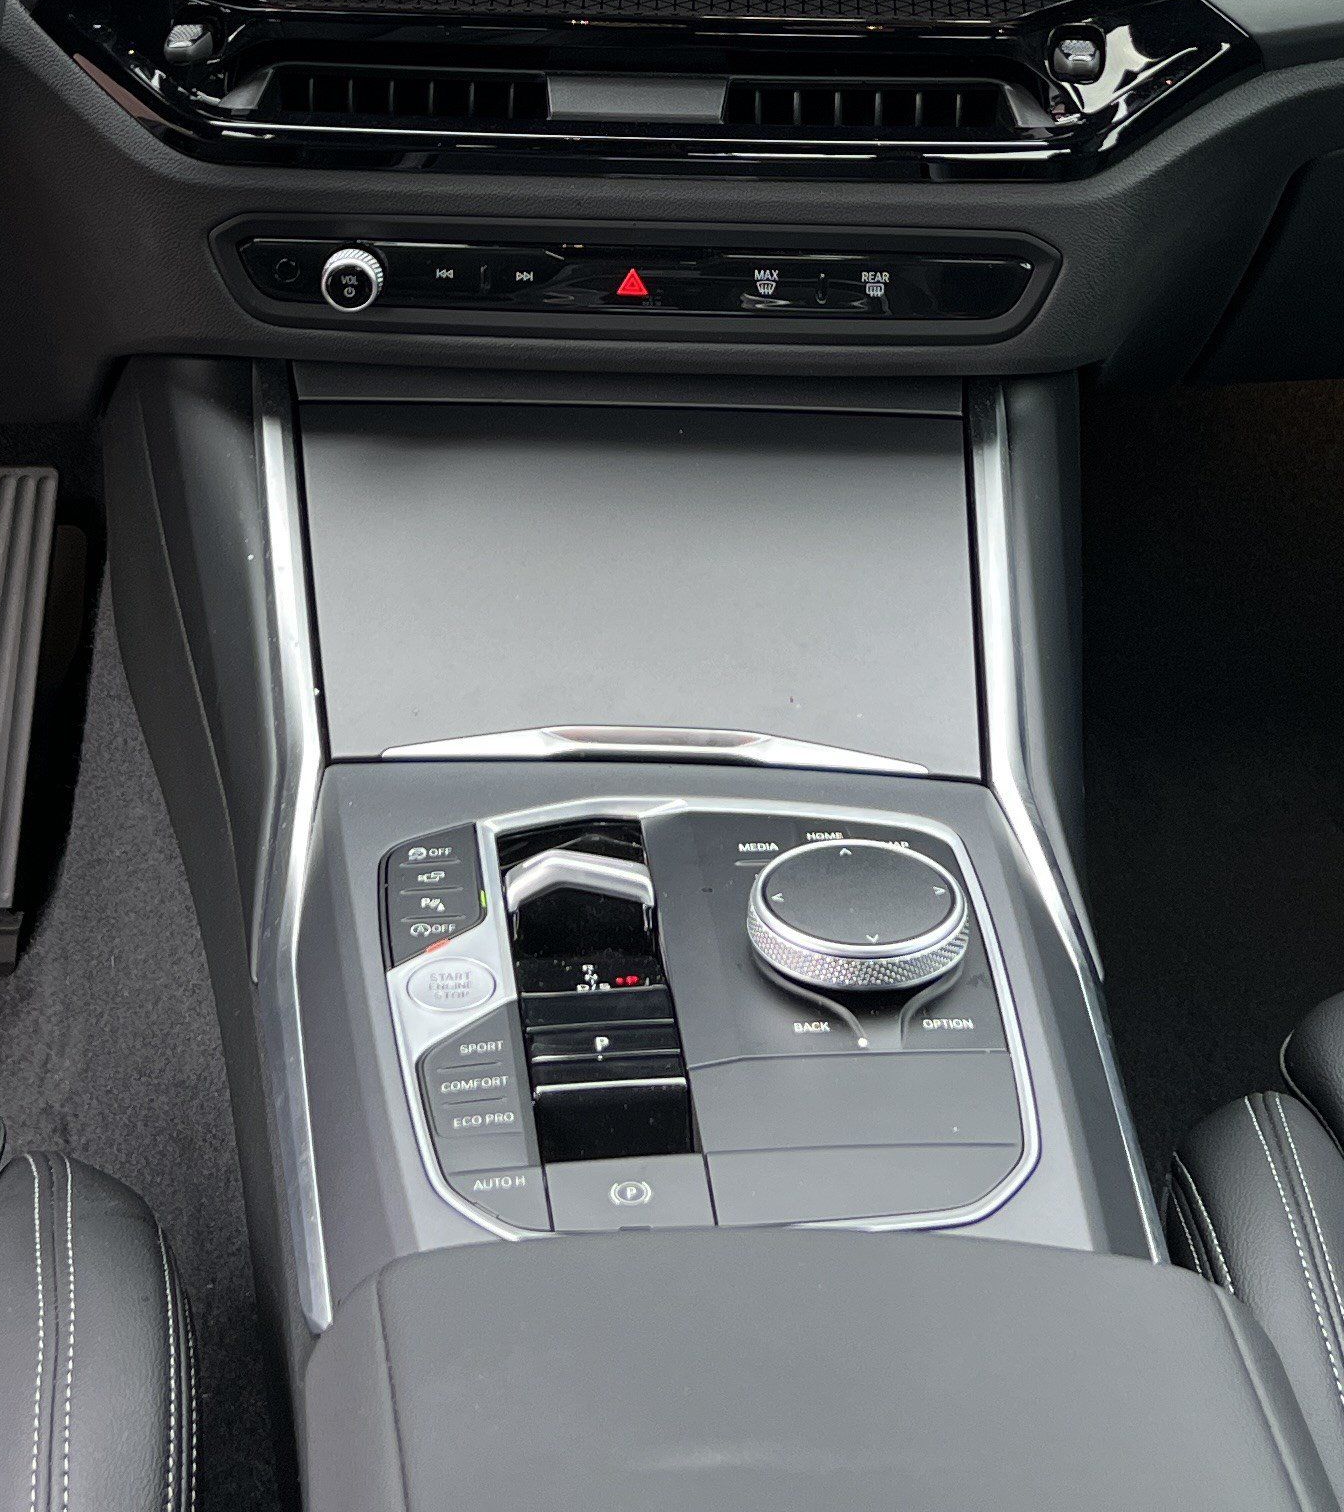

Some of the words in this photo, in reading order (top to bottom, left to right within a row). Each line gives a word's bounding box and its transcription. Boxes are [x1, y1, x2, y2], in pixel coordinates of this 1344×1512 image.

[754, 269, 779, 281] MAX
[861, 271, 890, 283] REAR
[806, 832, 844, 841] HOME
[428, 847, 453, 857] OFF
[737, 841, 779, 853] MEDIA
[431, 923, 456, 934] OFF
[793, 1021, 831, 1033] BACK
[922, 1018, 974, 1030] OPTION
[459, 1040, 504, 1054] SPORT
[595, 1036, 609, 1052] P
[441, 1075, 509, 1093] COMFORT
[453, 1115, 483, 1128] ECO
[485, 1112, 515, 1125] PRO
[473, 1176, 512, 1190] AUTO
[515, 1175, 526, 1187] H
